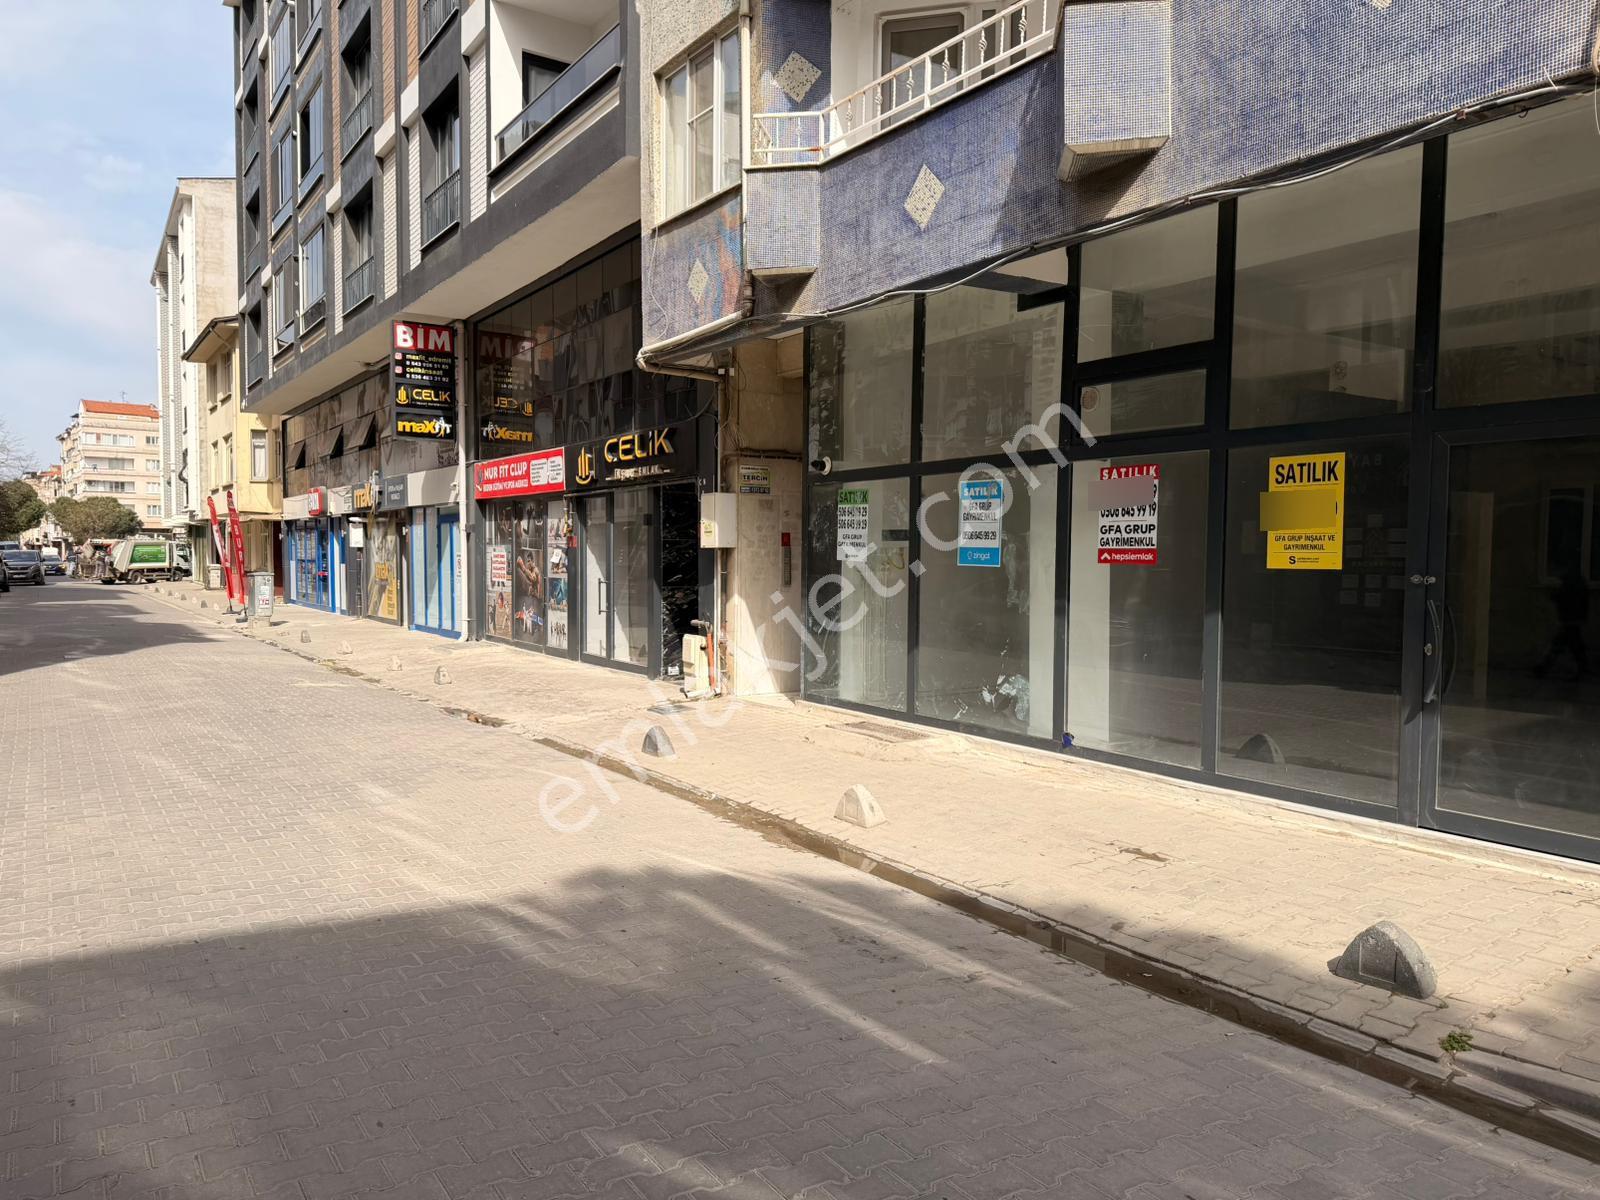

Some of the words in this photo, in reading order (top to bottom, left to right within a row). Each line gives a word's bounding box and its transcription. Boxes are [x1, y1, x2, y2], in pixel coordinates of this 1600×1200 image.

[1102, 465, 1157, 480] SATILIK
[1275, 460, 1339, 485] SATILIK
[1100, 524, 1122, 535] GFA
[1124, 524, 1156, 535] GRUP
[1274, 534, 1286, 542] GFA
[1287, 534, 1303, 542] GRUP
[1327, 534, 1336, 542] VE
[1111, 552, 1154, 562] hepsiemlak
